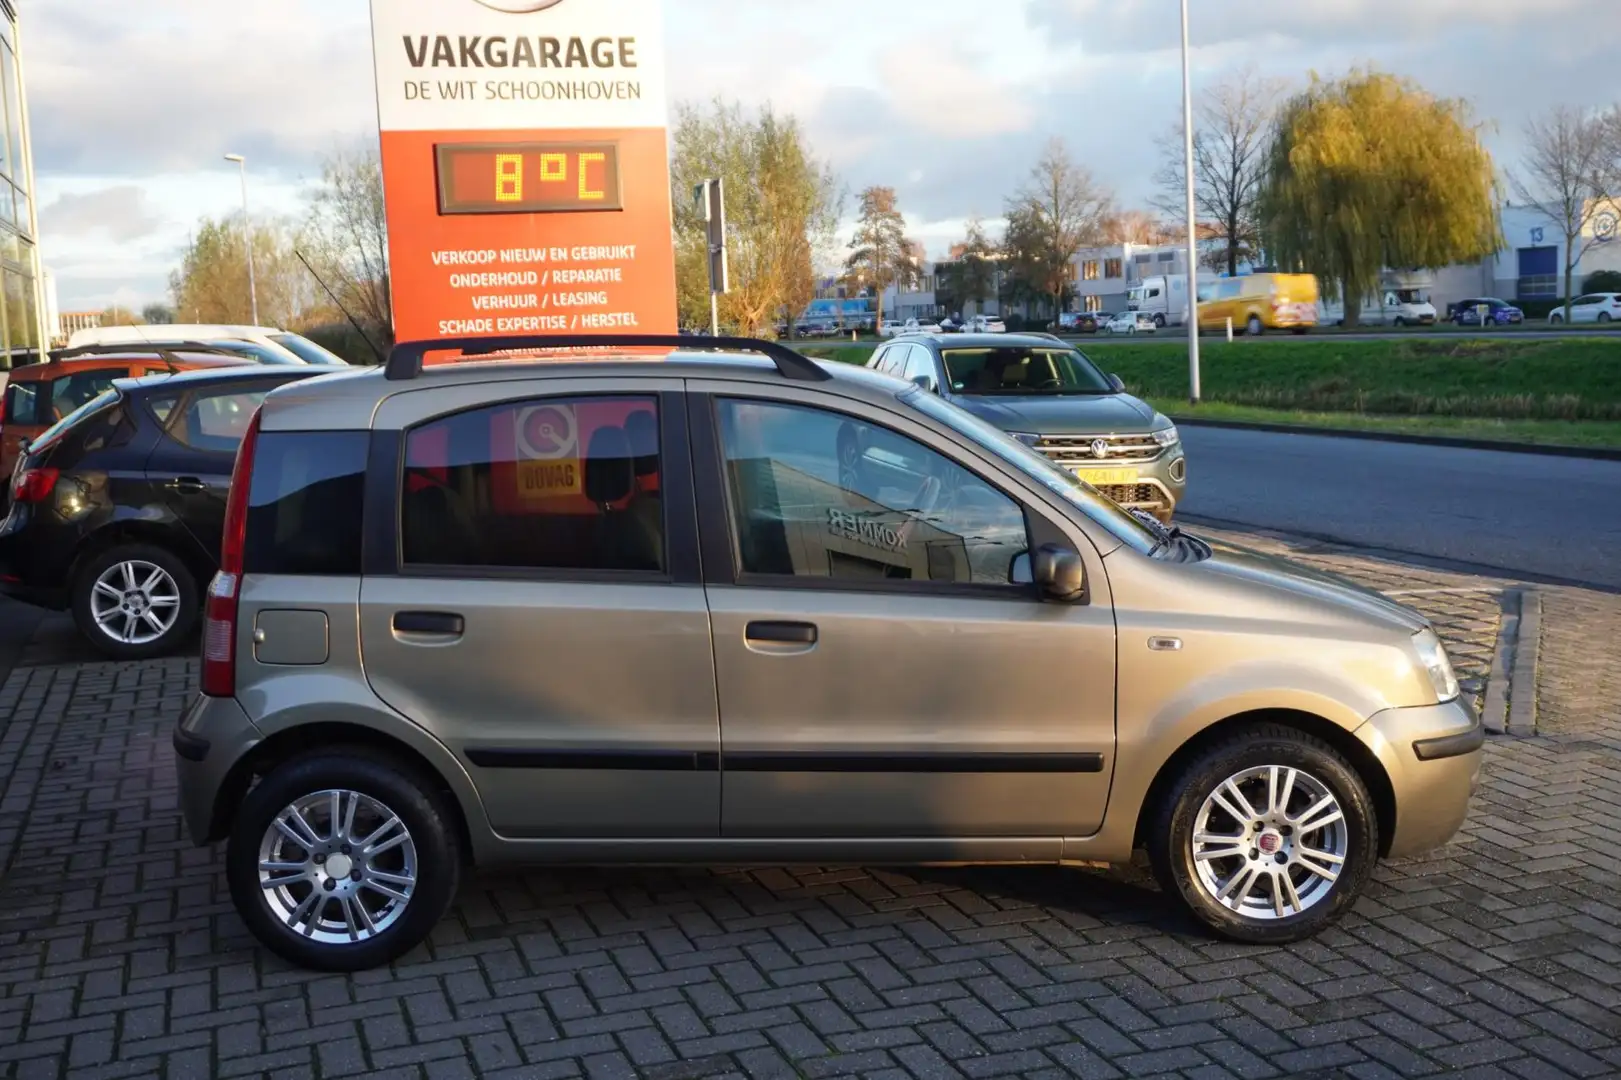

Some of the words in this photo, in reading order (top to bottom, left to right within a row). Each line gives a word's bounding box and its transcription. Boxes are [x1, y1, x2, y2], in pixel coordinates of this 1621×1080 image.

[402, 35, 638, 69] VAKGARAGE
[404, 80, 431, 100] DE
[438, 80, 478, 100] WIT
[485, 80, 641, 100] SCHOONHOVEN
[1529, 227, 1544, 242] 13
[431, 250, 497, 266] VERKOOP
[500, 247, 547, 263] NIEUW
[550, 246, 569, 261] EN
[572, 244, 637, 261] GEBRUIKT
[449, 270, 538, 288] ONDERHOUD
[552, 267, 623, 284] REPARATIE
[471, 293, 538, 310] VERHUUR
[552, 291, 608, 307] LEASING
[438, 317, 494, 335] SCHADE
[497, 313, 567, 331] EXPERTISE
[581, 312, 638, 328] HERSTEL
